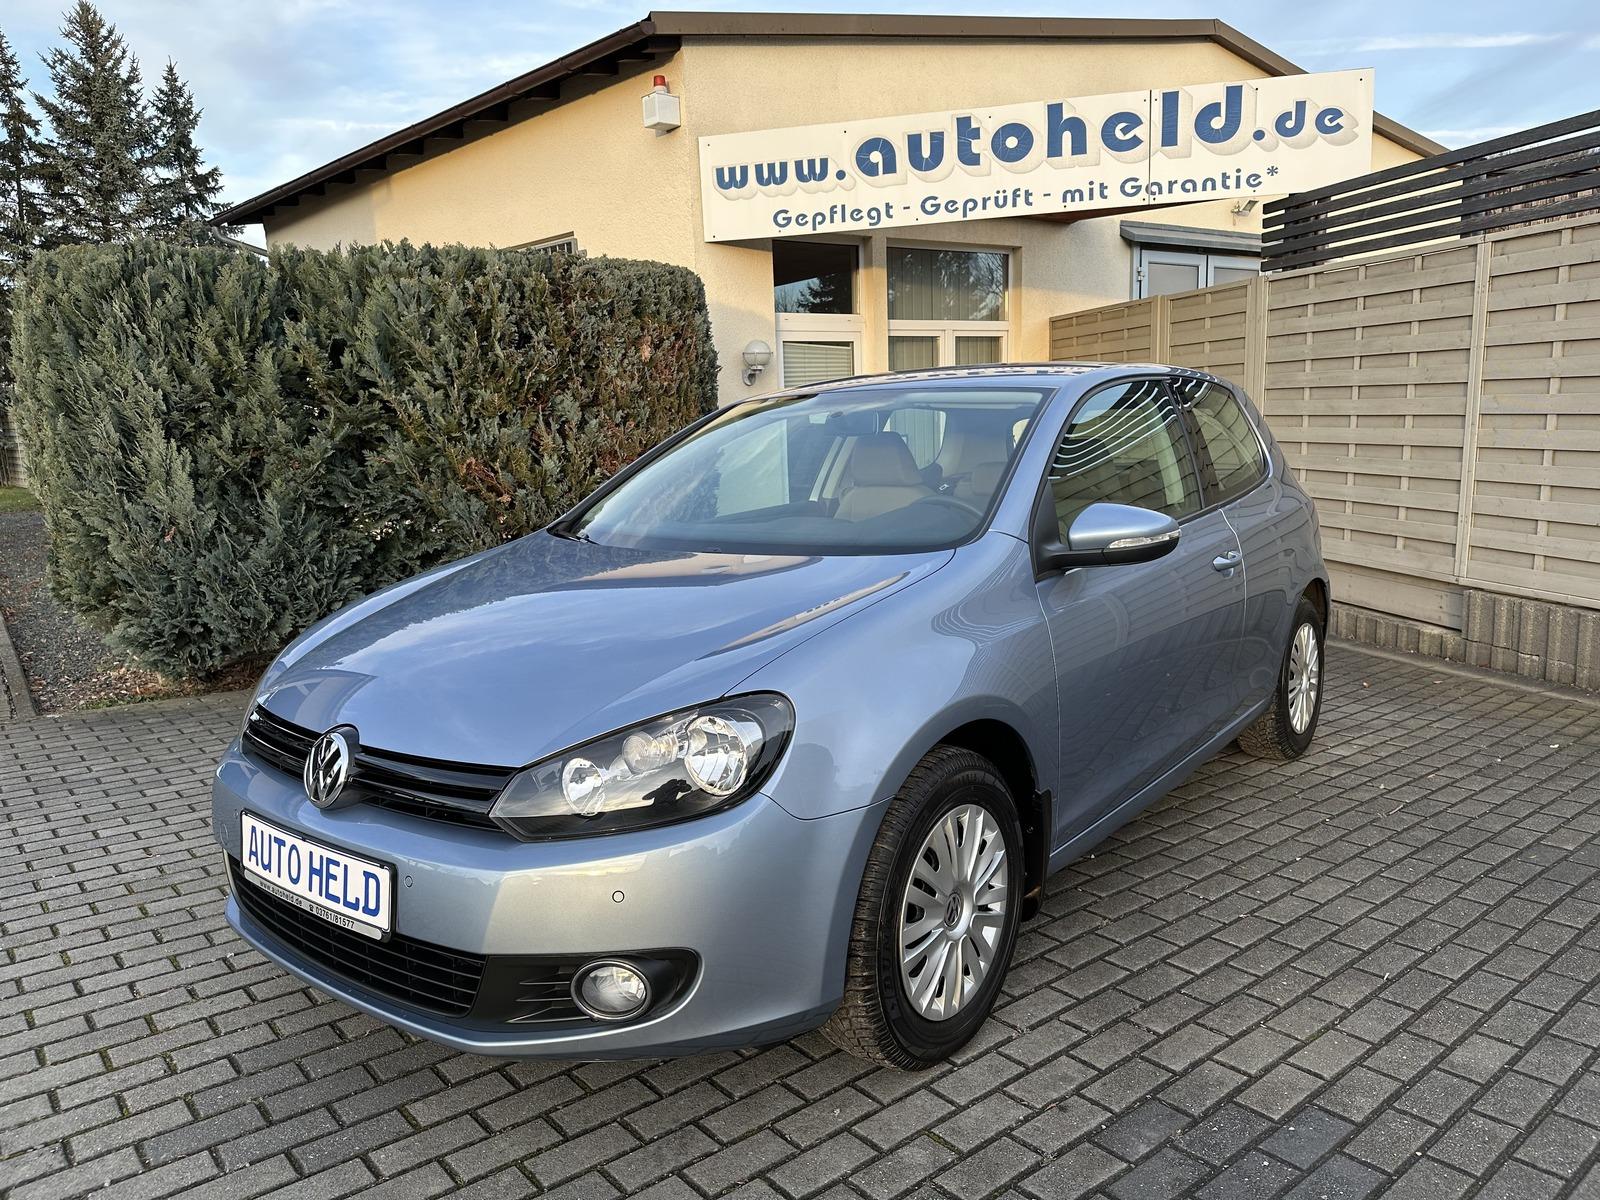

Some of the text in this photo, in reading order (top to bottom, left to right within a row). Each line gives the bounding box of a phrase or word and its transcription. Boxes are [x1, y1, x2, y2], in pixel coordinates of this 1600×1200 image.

[716, 84, 1344, 190] www.autoheld.de
[772, 202, 894, 231] Gepflegt
[920, 187, 1034, 219] Geprüft
[1062, 180, 1108, 204] mit
[248, 825, 381, 917] AUTO HELD
[259, 880, 355, 929] www.autoheld.de 03761/81577
